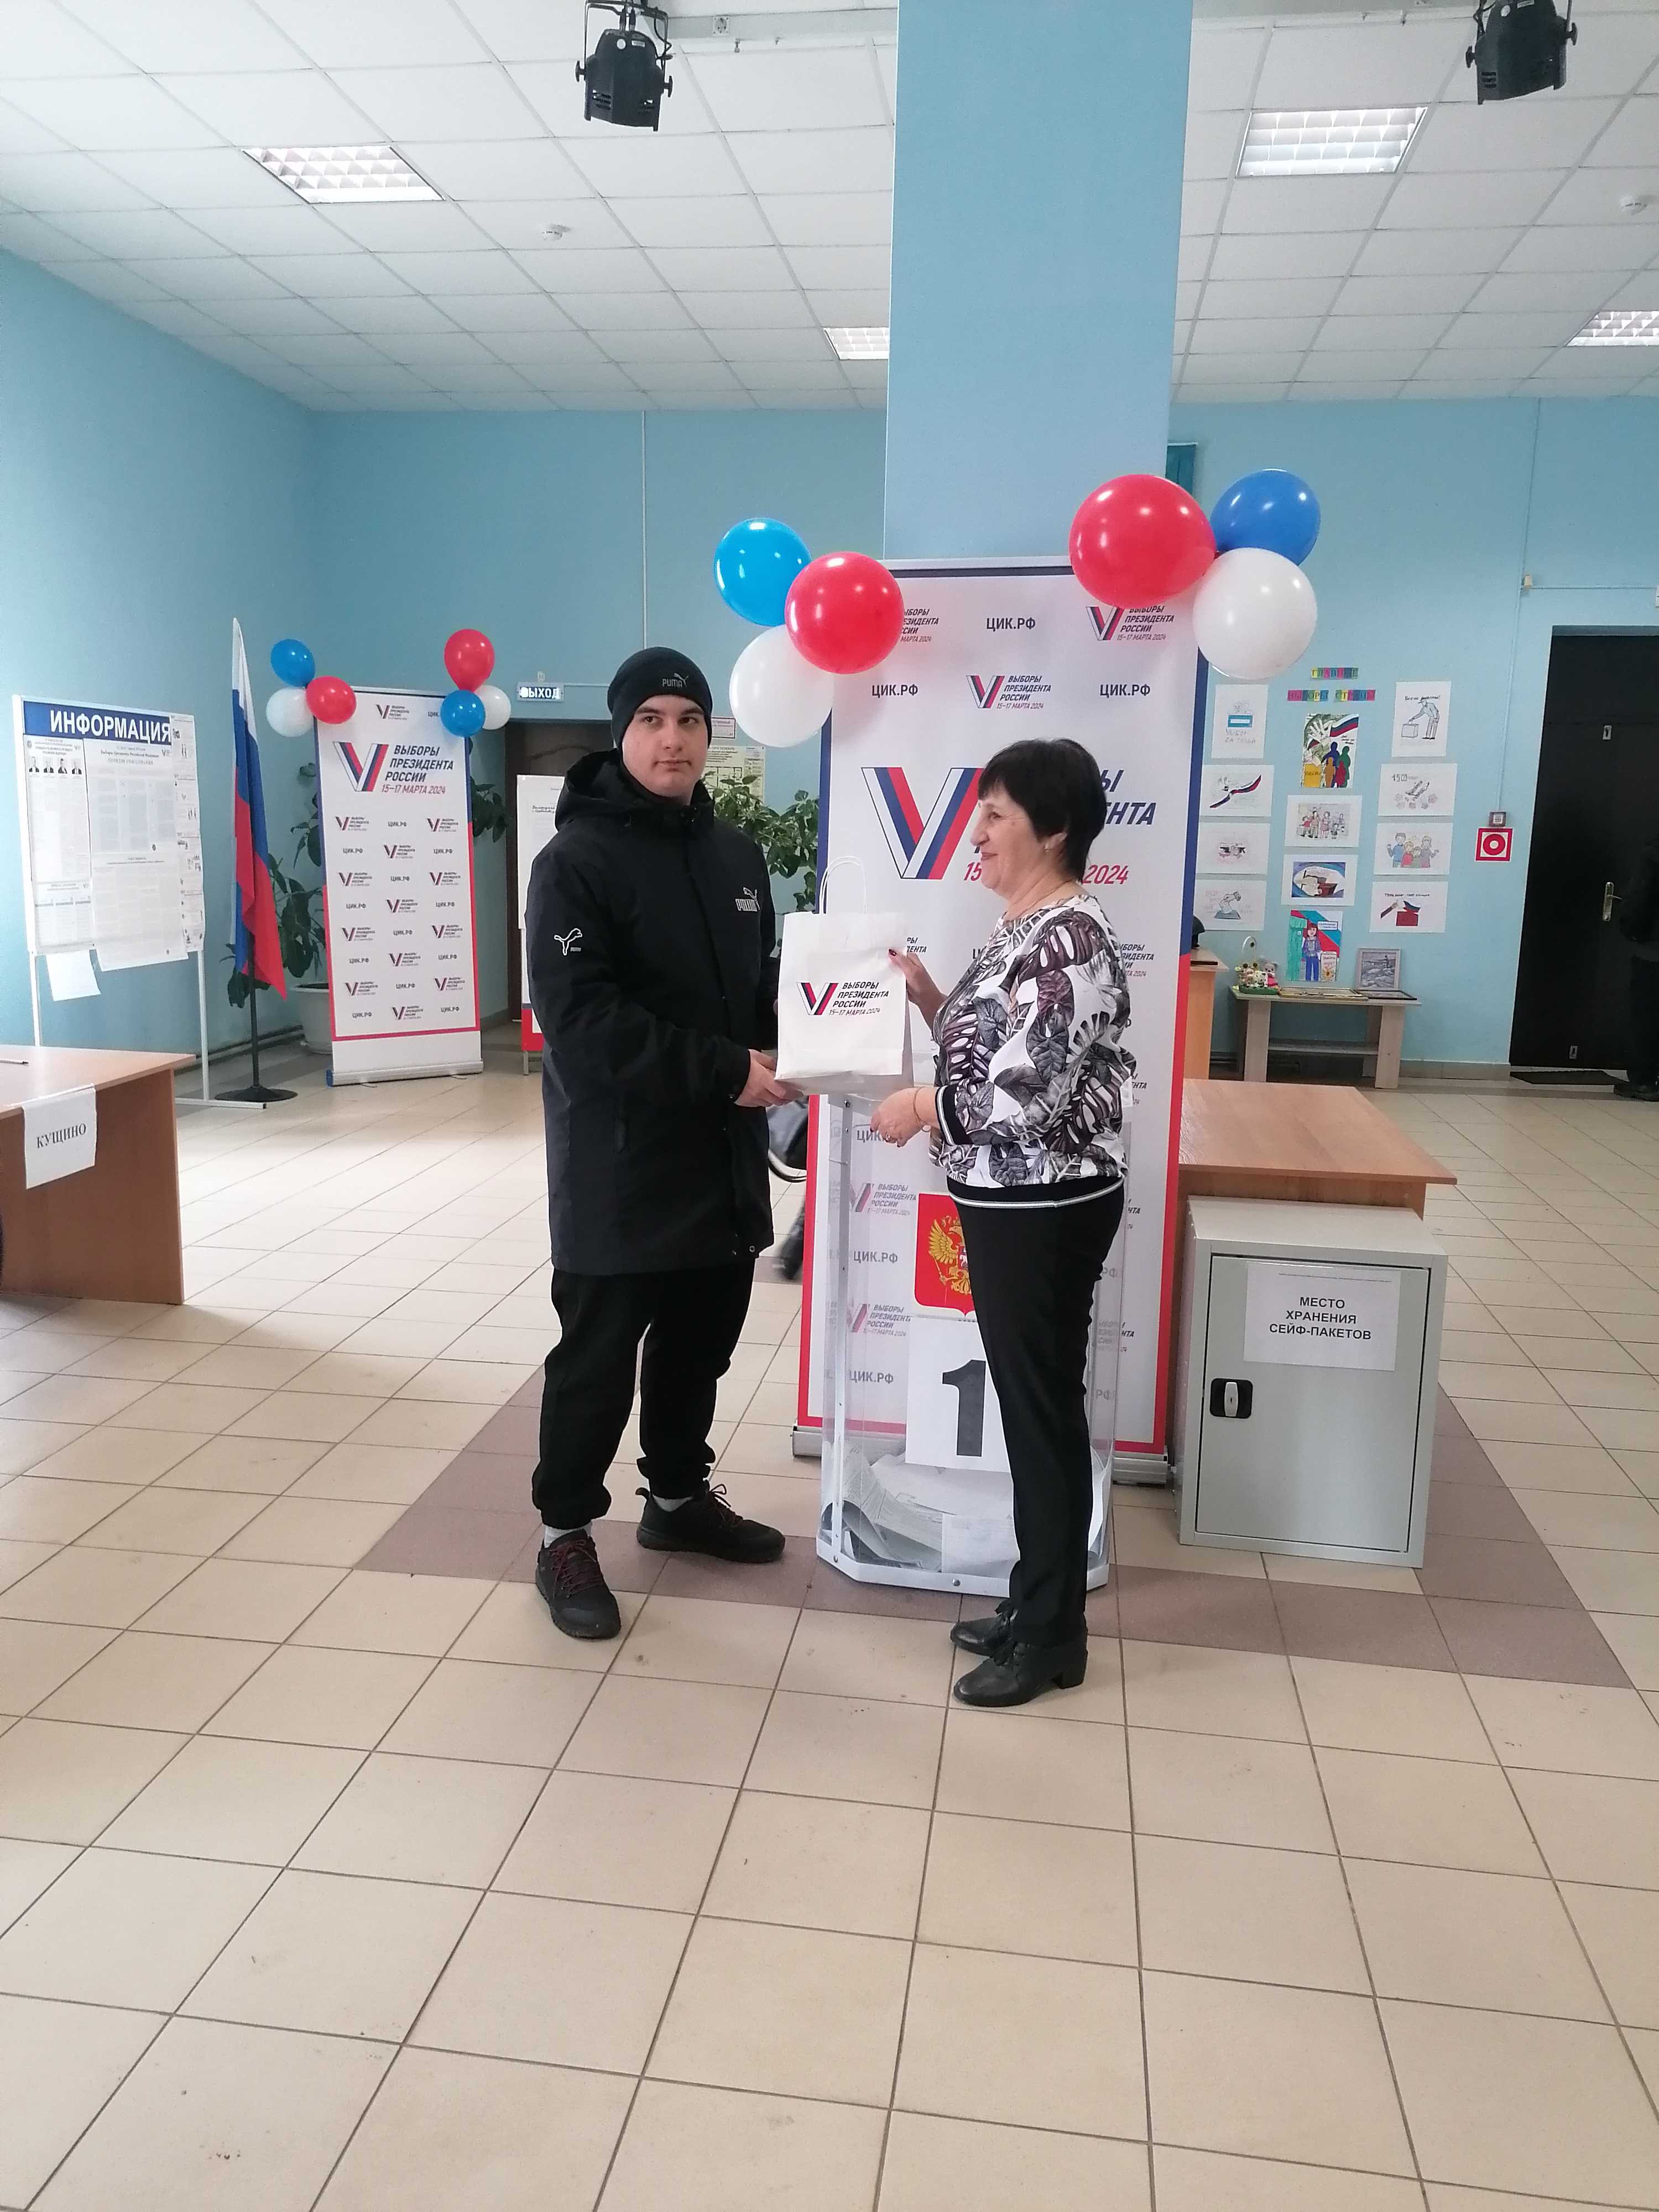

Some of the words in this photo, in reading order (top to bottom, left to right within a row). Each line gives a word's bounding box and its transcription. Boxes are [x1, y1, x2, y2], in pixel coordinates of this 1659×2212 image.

[987, 617, 1036, 632] ЦИК.РФ
[662, 679, 682, 688] PUMA
[1004, 685, 1051, 693] ПРЕЗИДЕНТА
[520, 687, 560, 699] ЫХОД
[872, 684, 919, 697] ЦИК.РФ
[1100, 684, 1150, 698] ЦИК.РФ
[50, 709, 171, 744] ИНФОРМАЦИЯ
[394, 745, 440, 757] ВЫБОРЫ
[389, 758, 454, 770] ПРЕЗИДЕНТА
[385, 771, 427, 782] РОССИИ
[402, 785, 427, 794] МАРТА
[428, 786, 446, 795] 2024
[1083, 864, 1129, 885] 2024
[837, 991, 889, 1000] ПРЕЗИДЕНТА
[37, 1123, 86, 1149] КУЩИНО
[857, 1130, 884, 1142] ЦИК.
[874, 1192, 916, 1201] ПРЕЗИДЕНТА
[853, 1251, 898, 1263] ЦИК.РФ
[1300, 1297, 1345, 1308] МЕСТО
[874, 1305, 904, 1313] ВЫБОРЫ
[1286, 1311, 1357, 1324] ХРАНЕНИЯ
[1270, 1323, 1371, 1339] СЕЙФ-ПАКЕТОВ
[850, 1370, 894, 1384] ЦИК.РФ
[942, 1359, 986, 1457] 1
